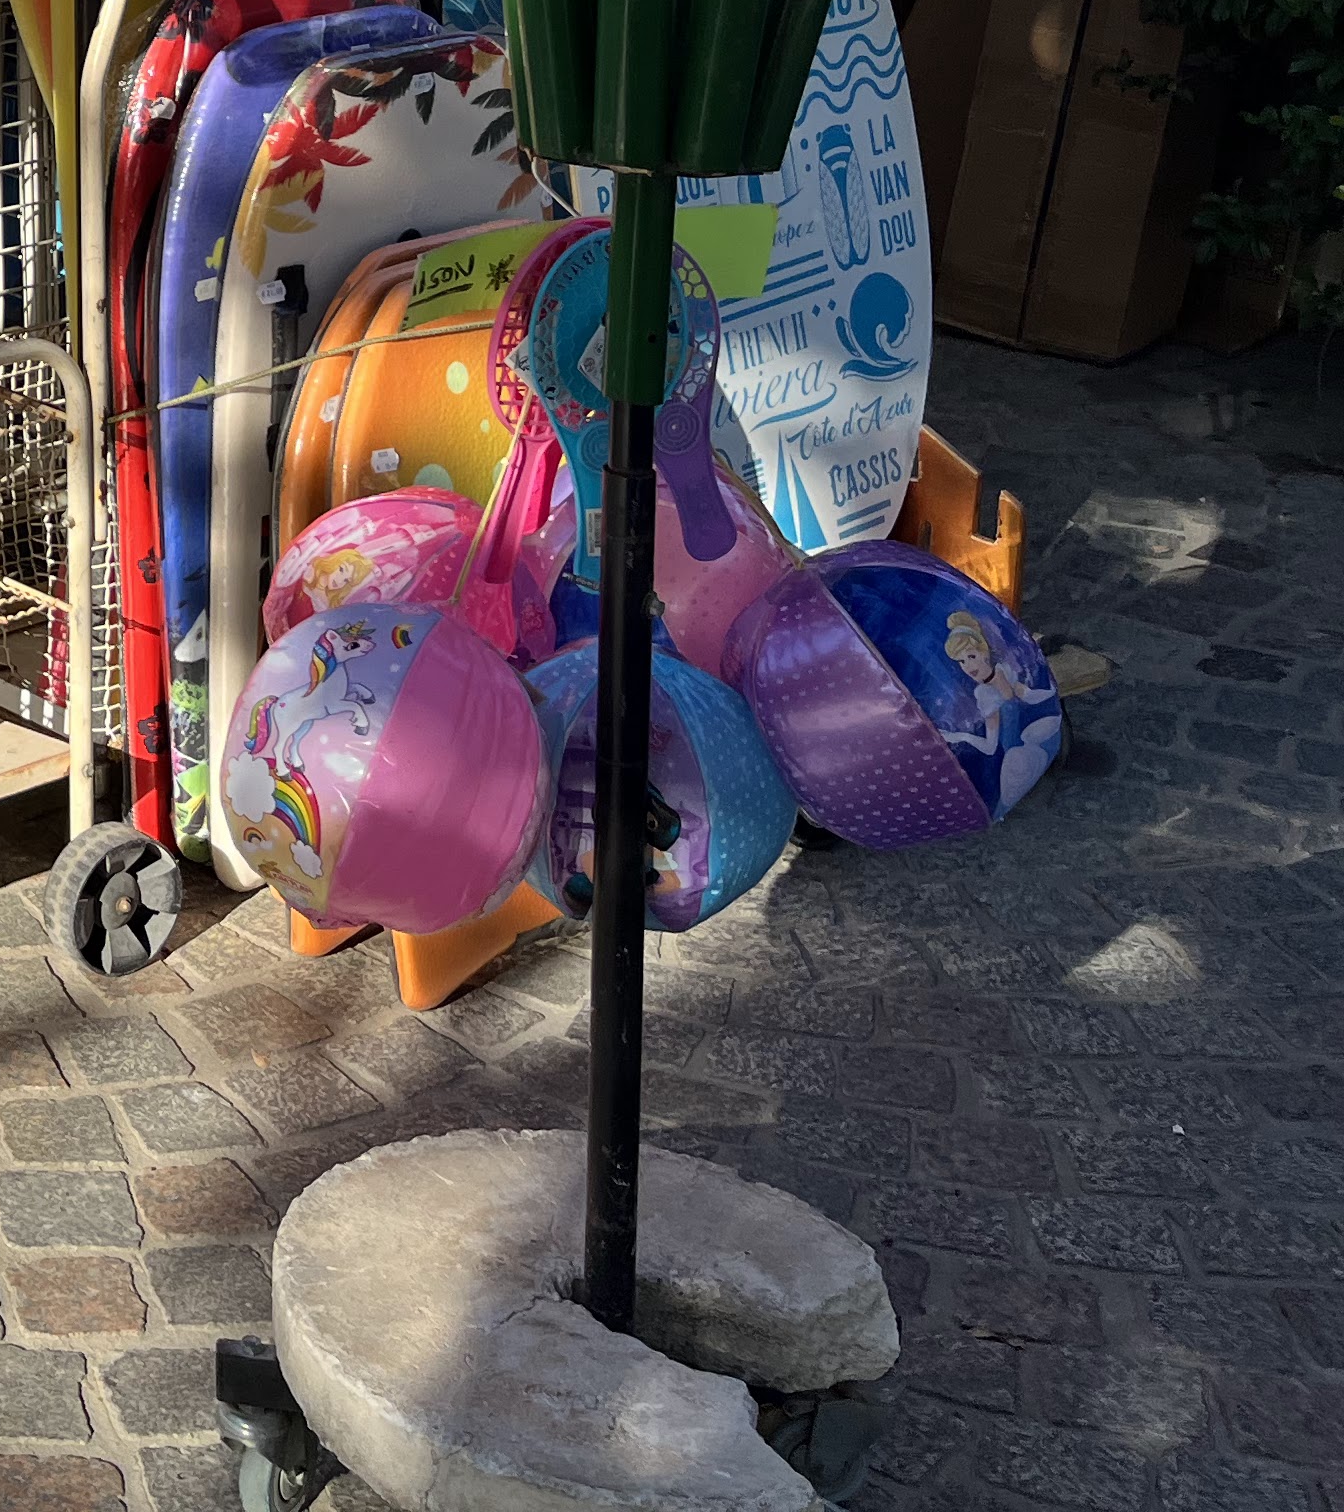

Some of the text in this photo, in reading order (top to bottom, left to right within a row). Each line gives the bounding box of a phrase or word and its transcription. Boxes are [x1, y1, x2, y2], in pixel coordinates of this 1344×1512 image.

[867, 114, 897, 156] LA
[870, 160, 911, 206] VAN
[879, 209, 917, 257] DOU
[723, 310, 809, 376] FRENCH
[786, 415, 837, 461] Côte
[828, 447, 902, 508] CASSIS
